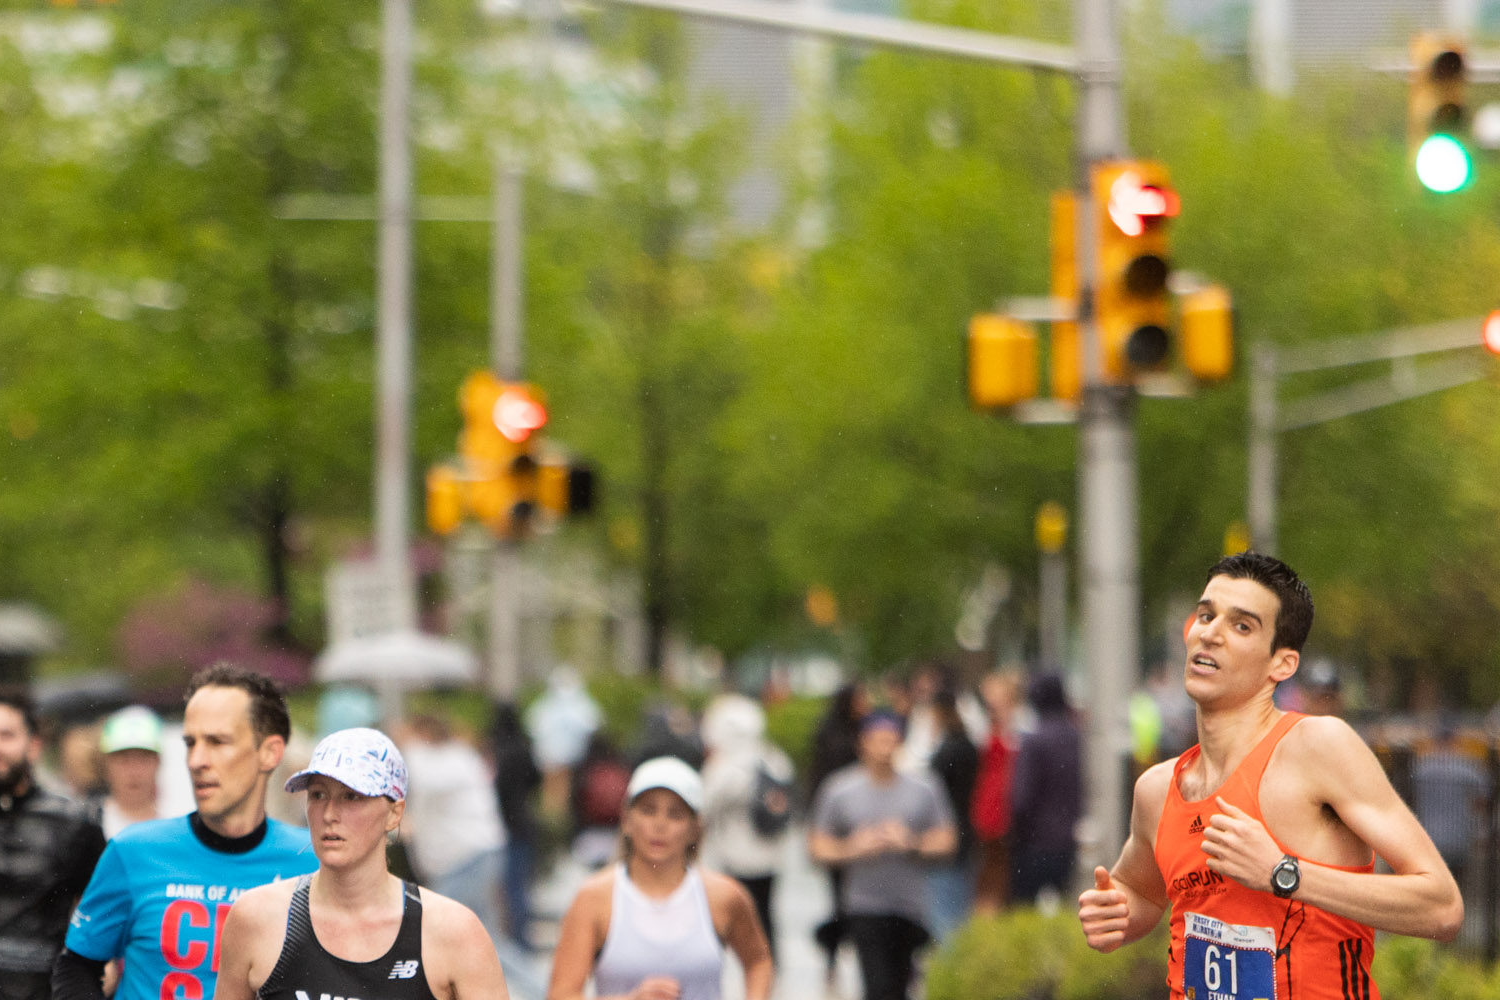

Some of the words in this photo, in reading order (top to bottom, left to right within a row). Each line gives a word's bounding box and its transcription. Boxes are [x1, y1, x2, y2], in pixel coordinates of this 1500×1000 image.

[165, 883, 205, 899] BANK
[207, 885, 227, 901] OF
[1204, 944, 1238, 995] 61
